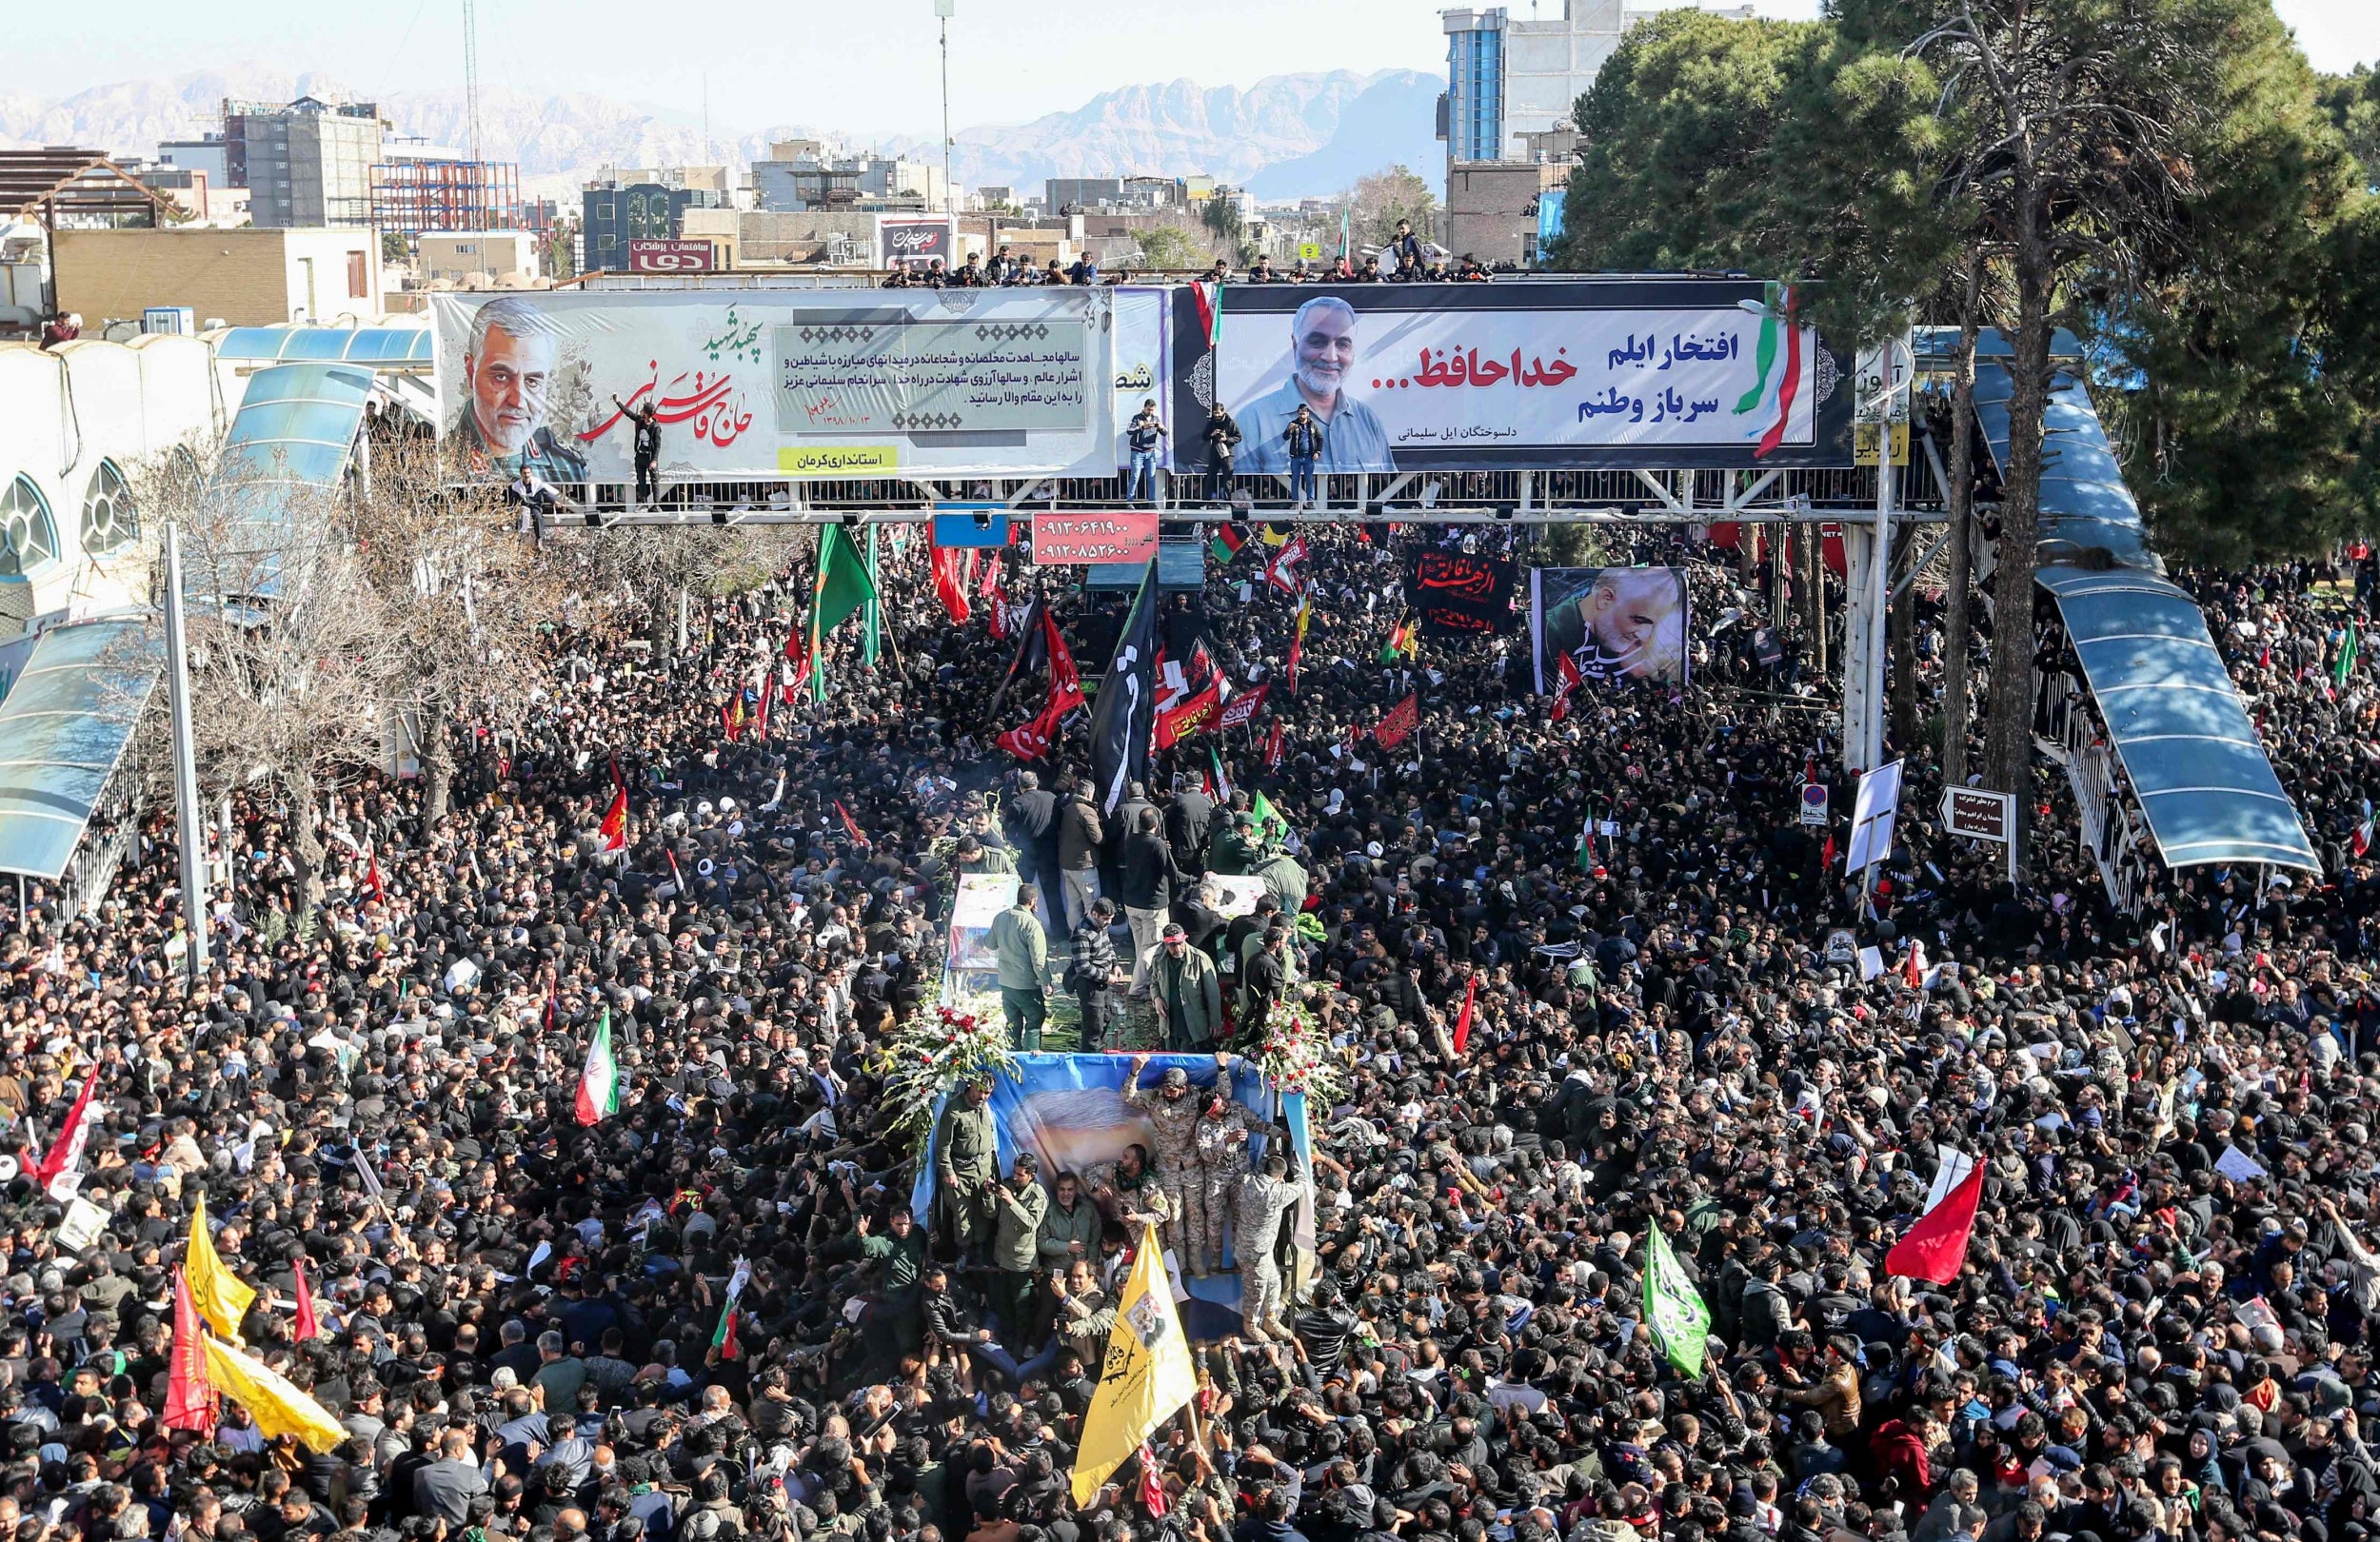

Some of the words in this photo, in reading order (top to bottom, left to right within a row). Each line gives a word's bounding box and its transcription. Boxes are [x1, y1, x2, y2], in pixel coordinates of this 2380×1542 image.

[632, 242, 666, 252] پزشکان
[671, 242, 709, 252] ساختمان
[640, 254, 704, 271] دی
[701, 301, 739, 362] شهید
[729, 321, 764, 365] سپهبد
[1657, 331, 1738, 370] افتخار
[783, 358, 790, 369] و
[791, 352, 828, 369] شیاطین
[828, 355, 838, 369] با
[838, 354, 865, 369] مبارزه
[909, 356, 920, 367] در
[921, 350, 958, 368] شجاعانه
[958, 357, 964, 367] و
[964, 351, 1005, 364] مخلصانه
[1056, 351, 1081, 366] سالها
[783, 374, 805, 389] عزیز
[806, 374, 845, 389] سلیمانی
[847, 373, 887, 389] سرانجام
[893, 372, 909, 386] خدا
[910, 374, 923, 387] راه
[924, 377, 935, 387] در
[937, 370, 969, 386] شهادت
[971, 369, 996, 386] آرزوی
[997, 372, 1021, 386] سالها
[1022, 376, 1029, 386] و
[1056, 368, 1081, 385] اشرار
[1005, 391, 1020, 405] والا
[1021, 390, 1042, 405] مقام
[1043, 391, 1061, 406] این
[1061, 393, 1073, 406] به
[1075, 391, 1082, 405] را
[1578, 386, 1644, 423] وطنم
[1649, 386, 1718, 423] سرباز
[712, 391, 753, 447] حاج
[1398, 427, 1437, 441] سلیمانی
[1440, 427, 1457, 441] ایل
[1460, 425, 1517, 440] دلسوختگان
[797, 454, 827, 469] کرمان
[827, 454, 882, 468] استانداری
[1041, 521, 1129, 535] ۰۹۱۳۰۶۴۱۹۰۰
